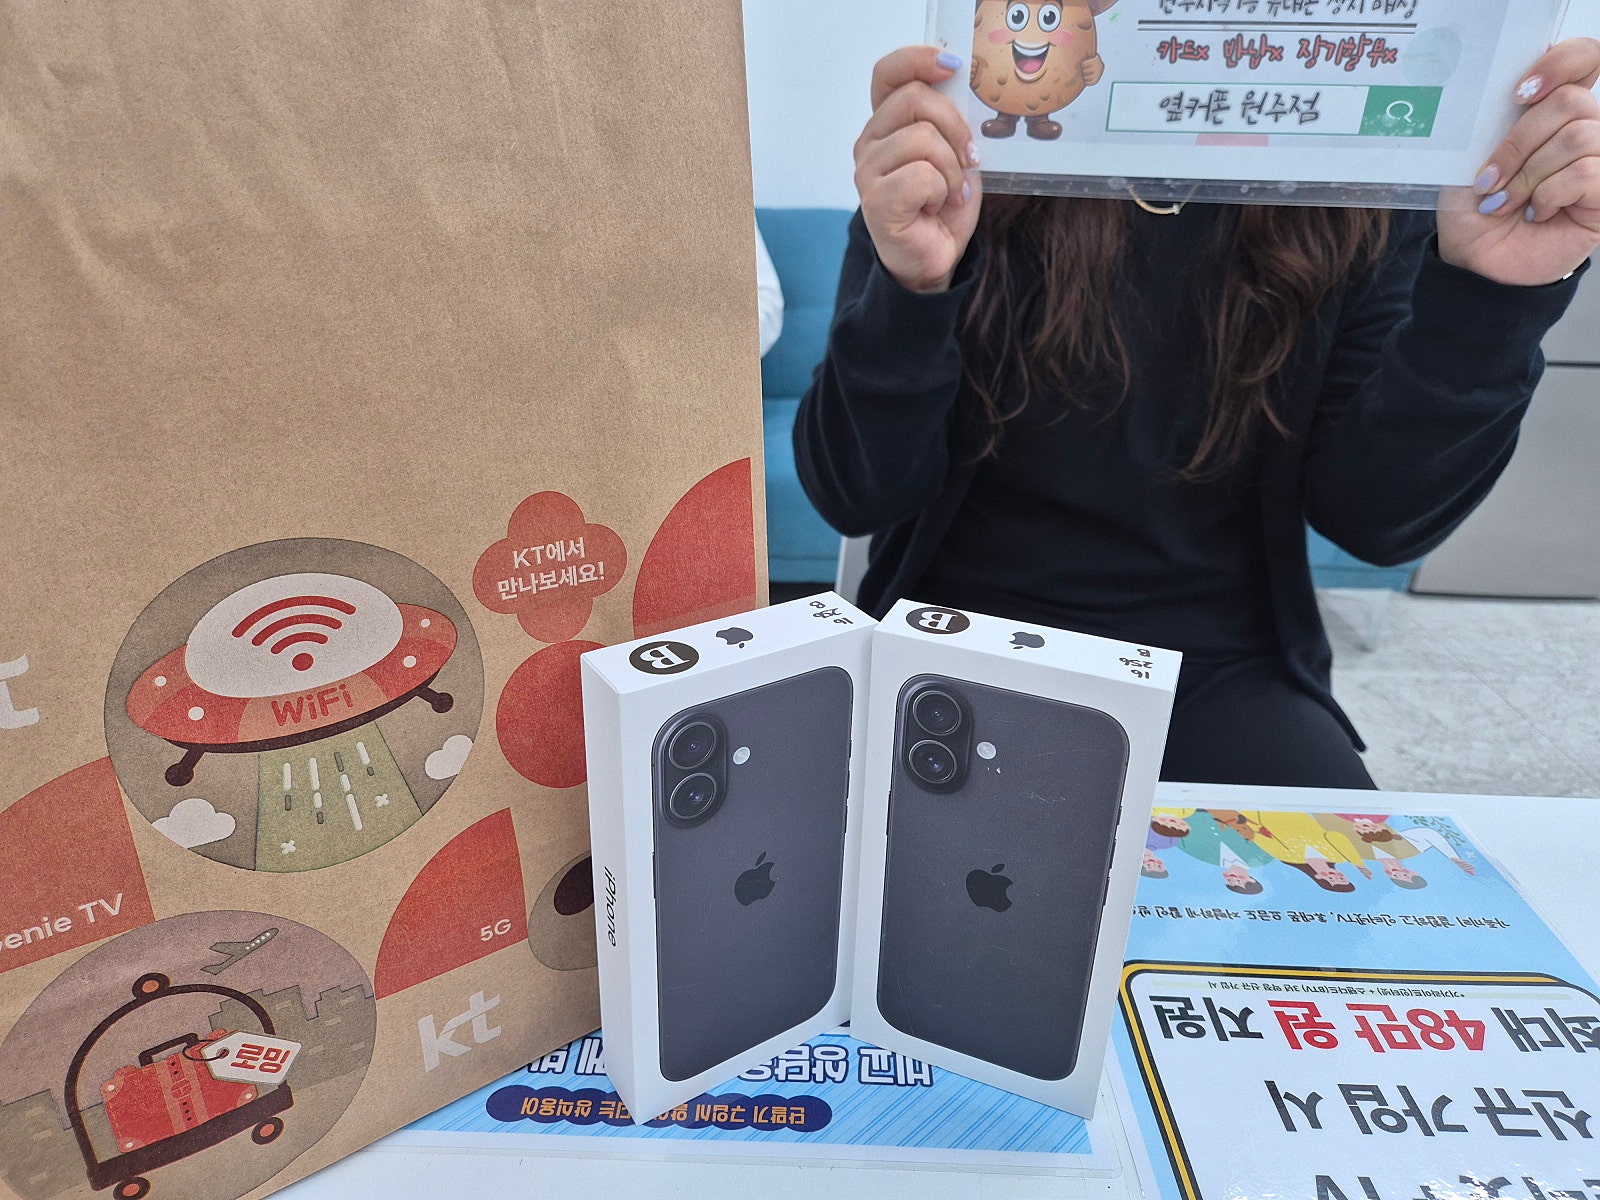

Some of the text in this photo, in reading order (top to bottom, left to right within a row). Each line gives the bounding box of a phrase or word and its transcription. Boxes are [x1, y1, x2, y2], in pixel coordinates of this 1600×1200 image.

[1159, 89, 1321, 125] 옆커폰 원주점
[513, 537, 585, 569] KT에서
[497, 561, 605, 601] 만나보세요!
[1130, 669, 1150, 679] 16
[271, 683, 354, 727] WiFi
[78, 892, 123, 924] TV
[604, 866, 617, 947] iPhone
[1154, 906, 1183, 919] 할인
[1243, 909, 1282, 923] 요금도
[1286, 911, 1328, 924] 휴대폰
[480, 918, 512, 942] 5G
[1399, 915, 1455, 929] 결합하고
[1455, 916, 1510, 929] 가족끼리
[1220, 982, 1239, 990] 가입
[1242, 983, 1259, 991] 신규
[418, 990, 501, 1073] kt
[1149, 995, 1600, 1053] 최대 48만 원 지원
[230, 1043, 291, 1074] 로밍
[520, 1096, 593, 1118] 상식용어
[694, 1103, 746, 1123] 구입시
[753, 1105, 805, 1125] 단말기
[1264, 1081, 1593, 1141] 신규 가입 시
